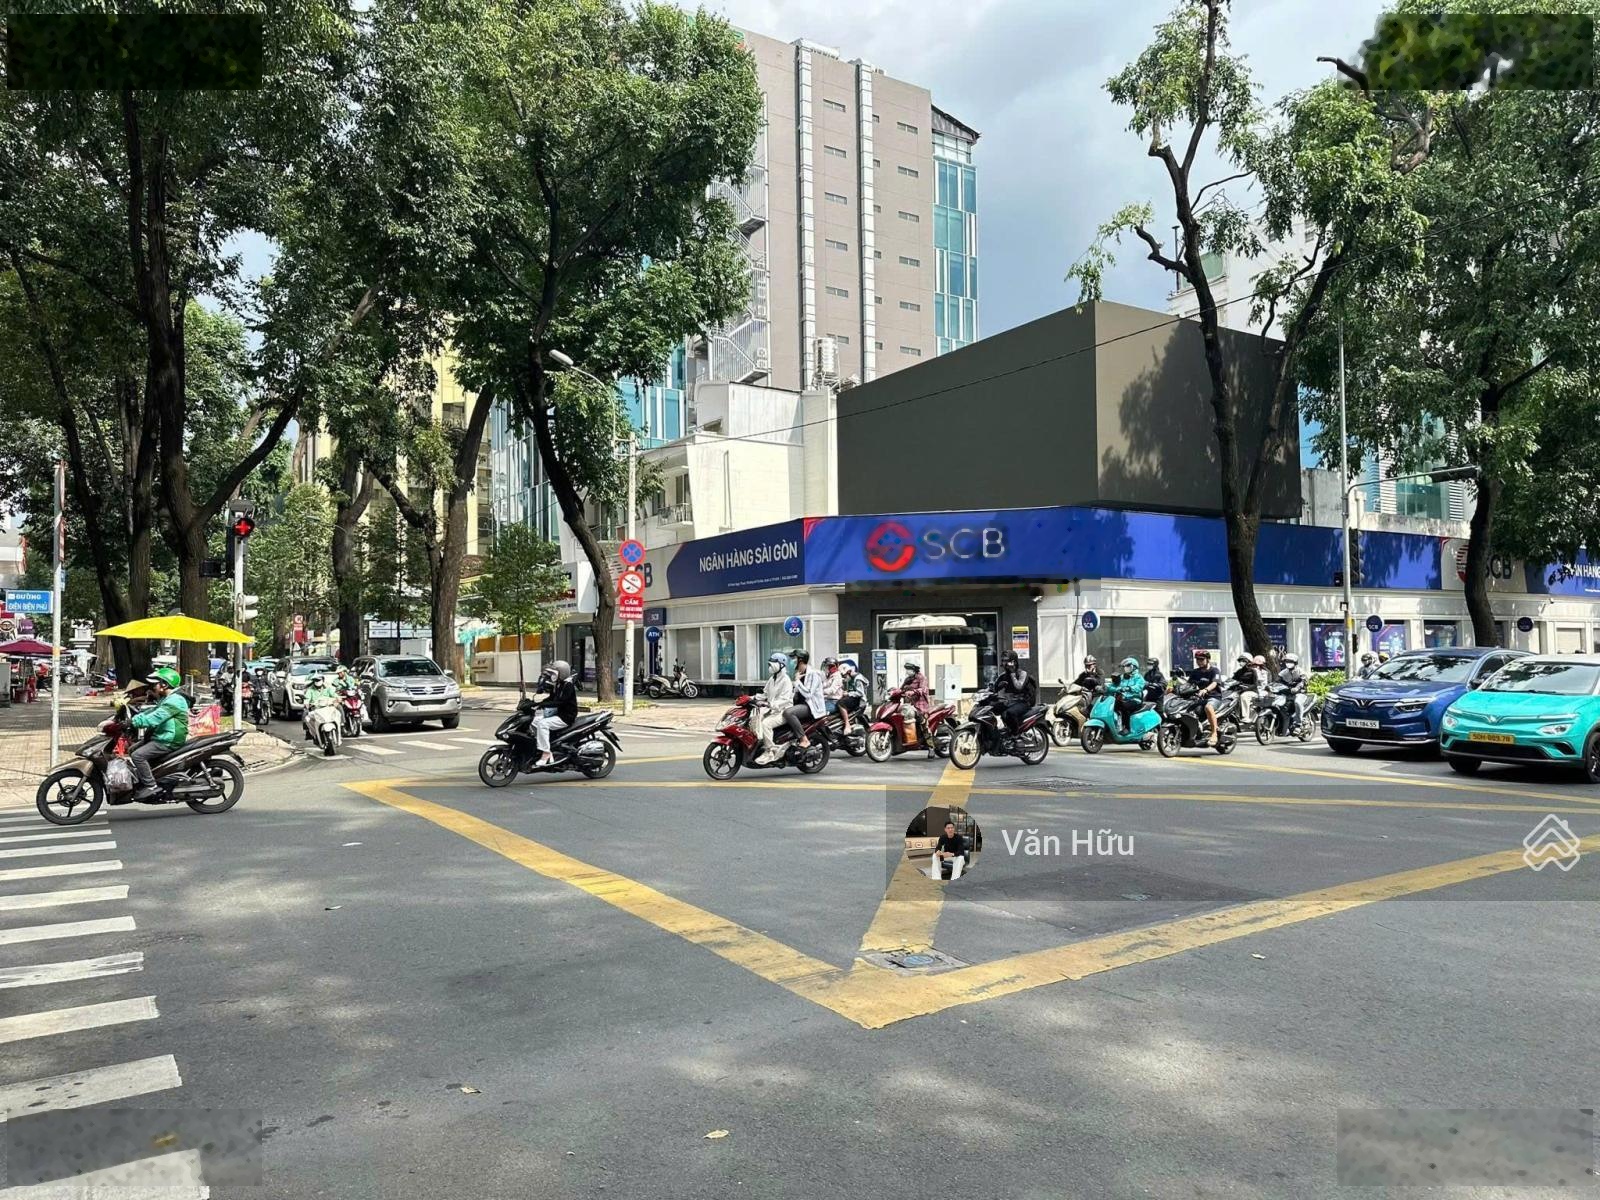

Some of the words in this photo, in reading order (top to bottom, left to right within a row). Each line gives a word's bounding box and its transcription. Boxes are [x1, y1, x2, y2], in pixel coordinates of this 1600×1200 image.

[699, 552, 725, 573] NGÂN
[726, 548, 754, 569] HÀNG
[754, 543, 772, 565] SÀI
[773, 539, 798, 562] GÒN
[923, 527, 1005, 560] SCB
